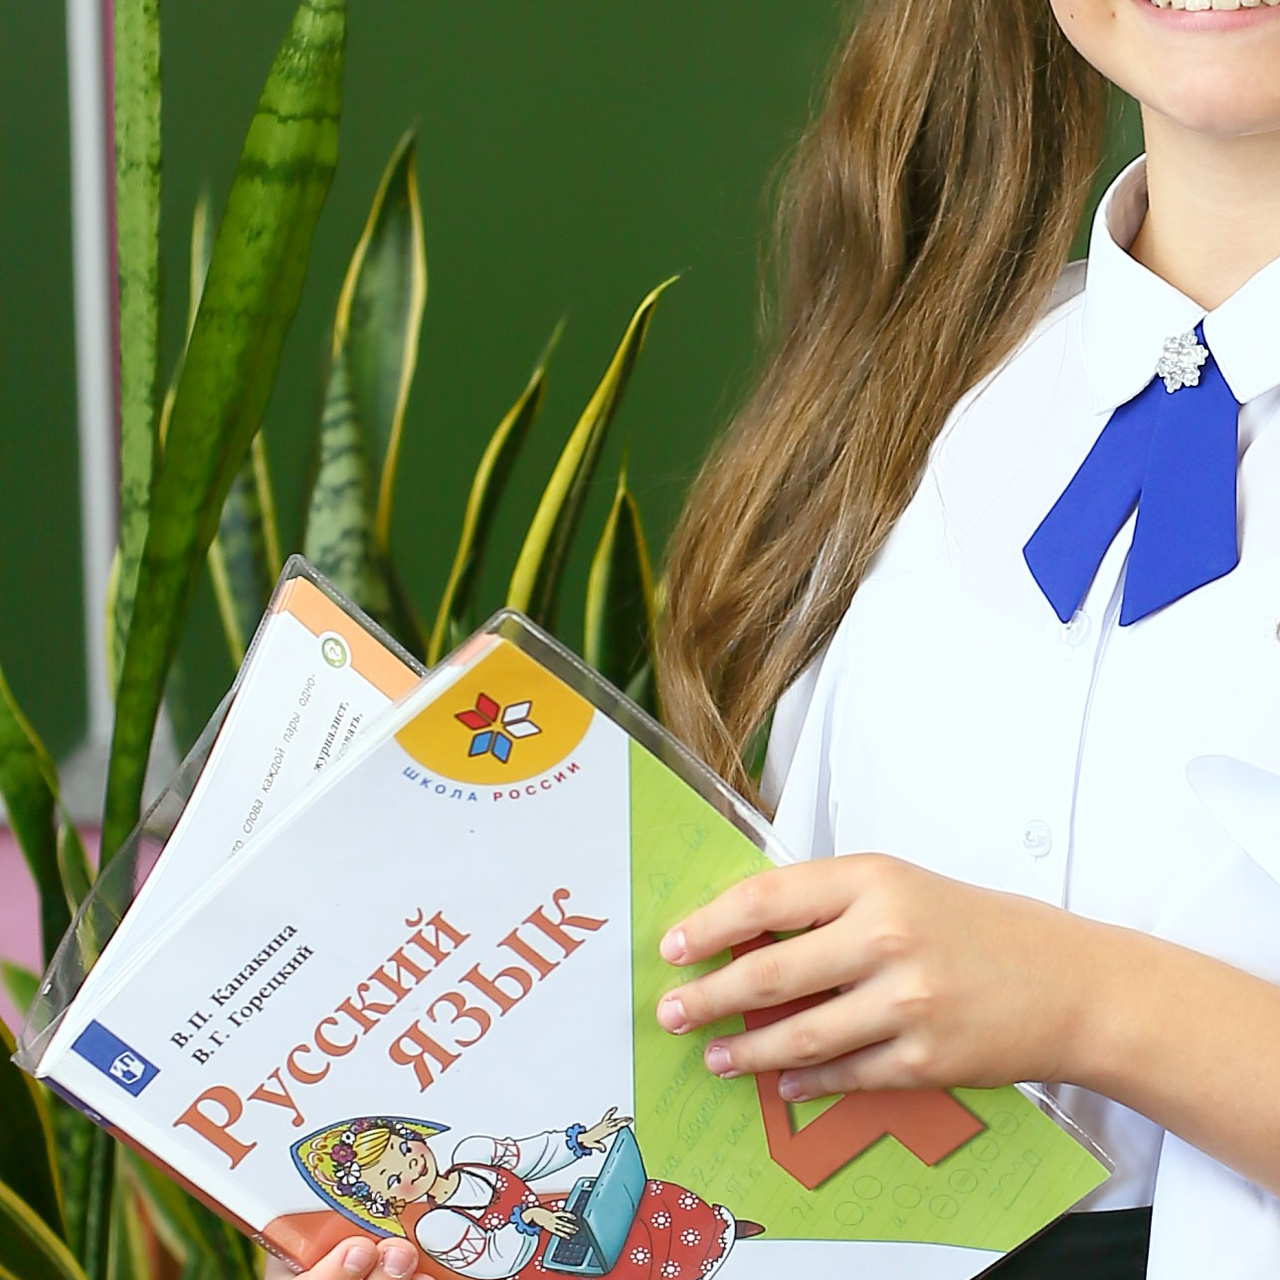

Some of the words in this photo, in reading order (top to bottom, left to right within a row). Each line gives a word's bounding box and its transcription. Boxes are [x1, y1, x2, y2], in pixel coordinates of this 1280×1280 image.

[242, 797, 264, 835] слова
[261, 746, 287, 794] каждой
[282, 711, 300, 745] пары
[298, 673, 317, 708] одно-
[313, 701, 351, 773] журналист,
[402, 765, 478, 802] ШКОЛА
[492, 761, 581, 802] РОССИИ
[169, 1031, 194, 1050] В.
[187, 1009, 214, 1031] П.
[208, 923, 299, 1008] Канакина
[172, 906, 472, 1171] Русский
[190, 1048, 215, 1066] В.
[208, 1029, 231, 1048] Г.
[226, 944, 316, 1029] Горецкий
